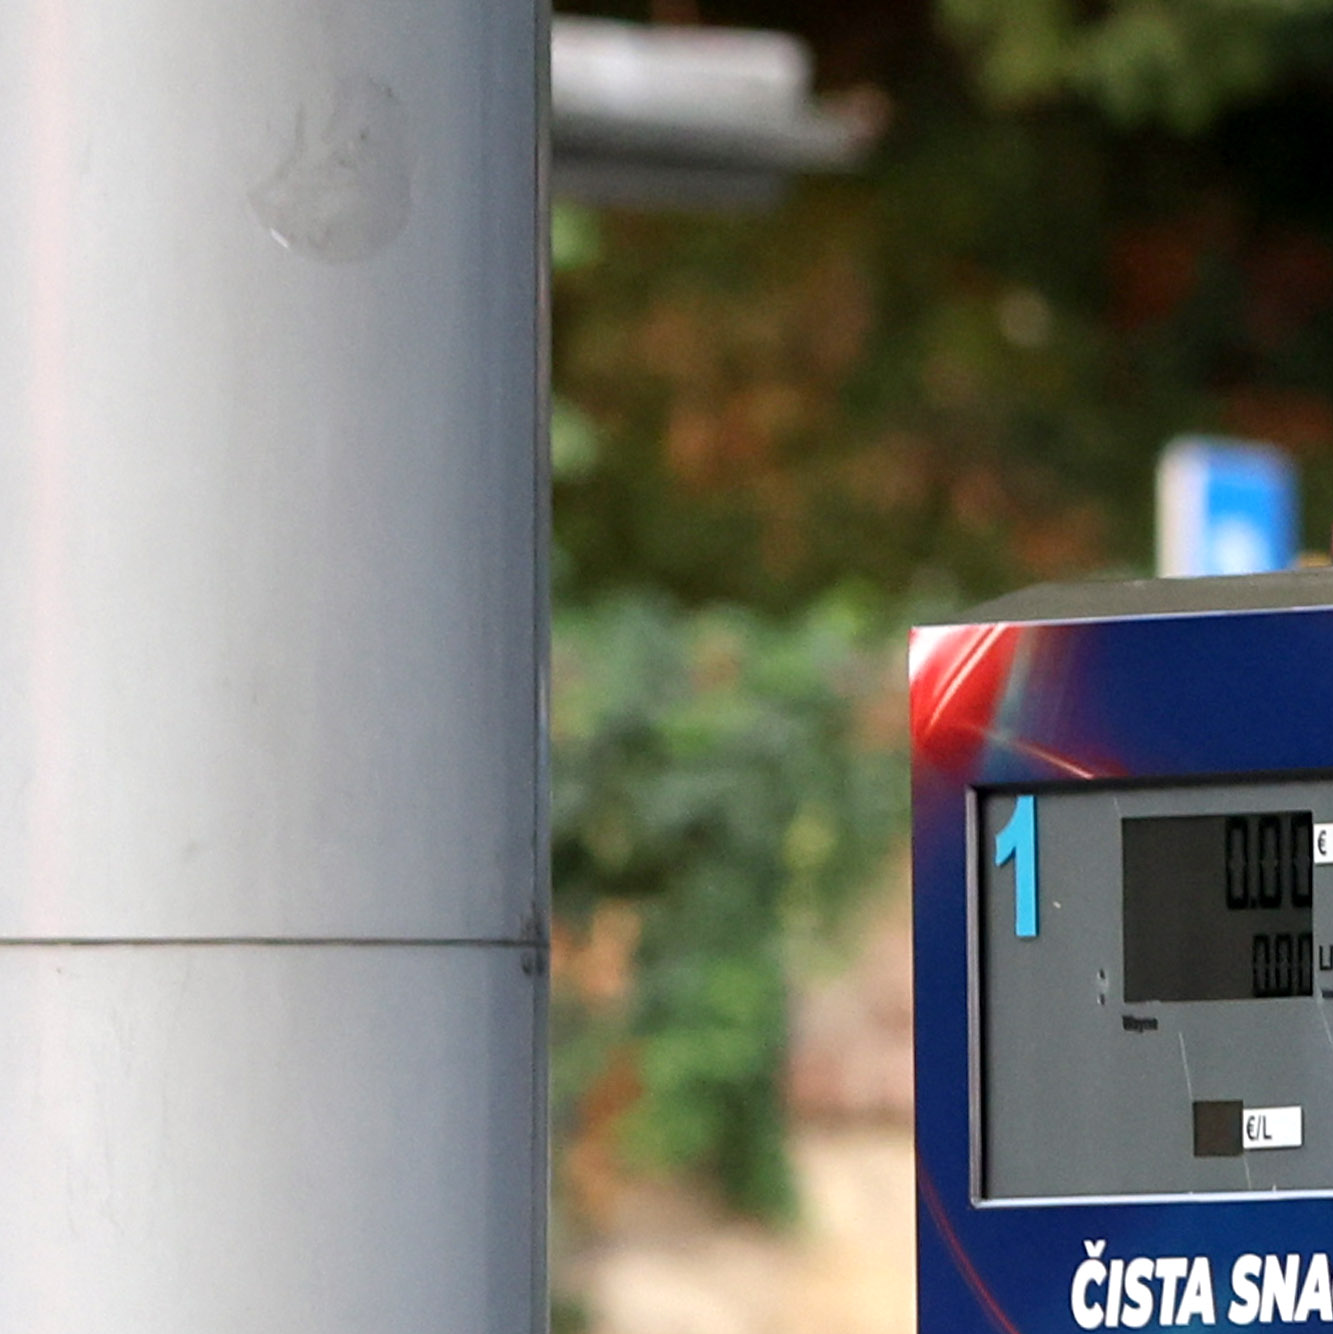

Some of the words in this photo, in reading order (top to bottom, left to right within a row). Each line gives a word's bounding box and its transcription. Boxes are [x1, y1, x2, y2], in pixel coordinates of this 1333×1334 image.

[994, 795, 1039, 939] 1
[1317, 830, 1327, 857] €
[1246, 1116, 1273, 1142] €/L
[1070, 1240, 1215, 1330] ČISTA
